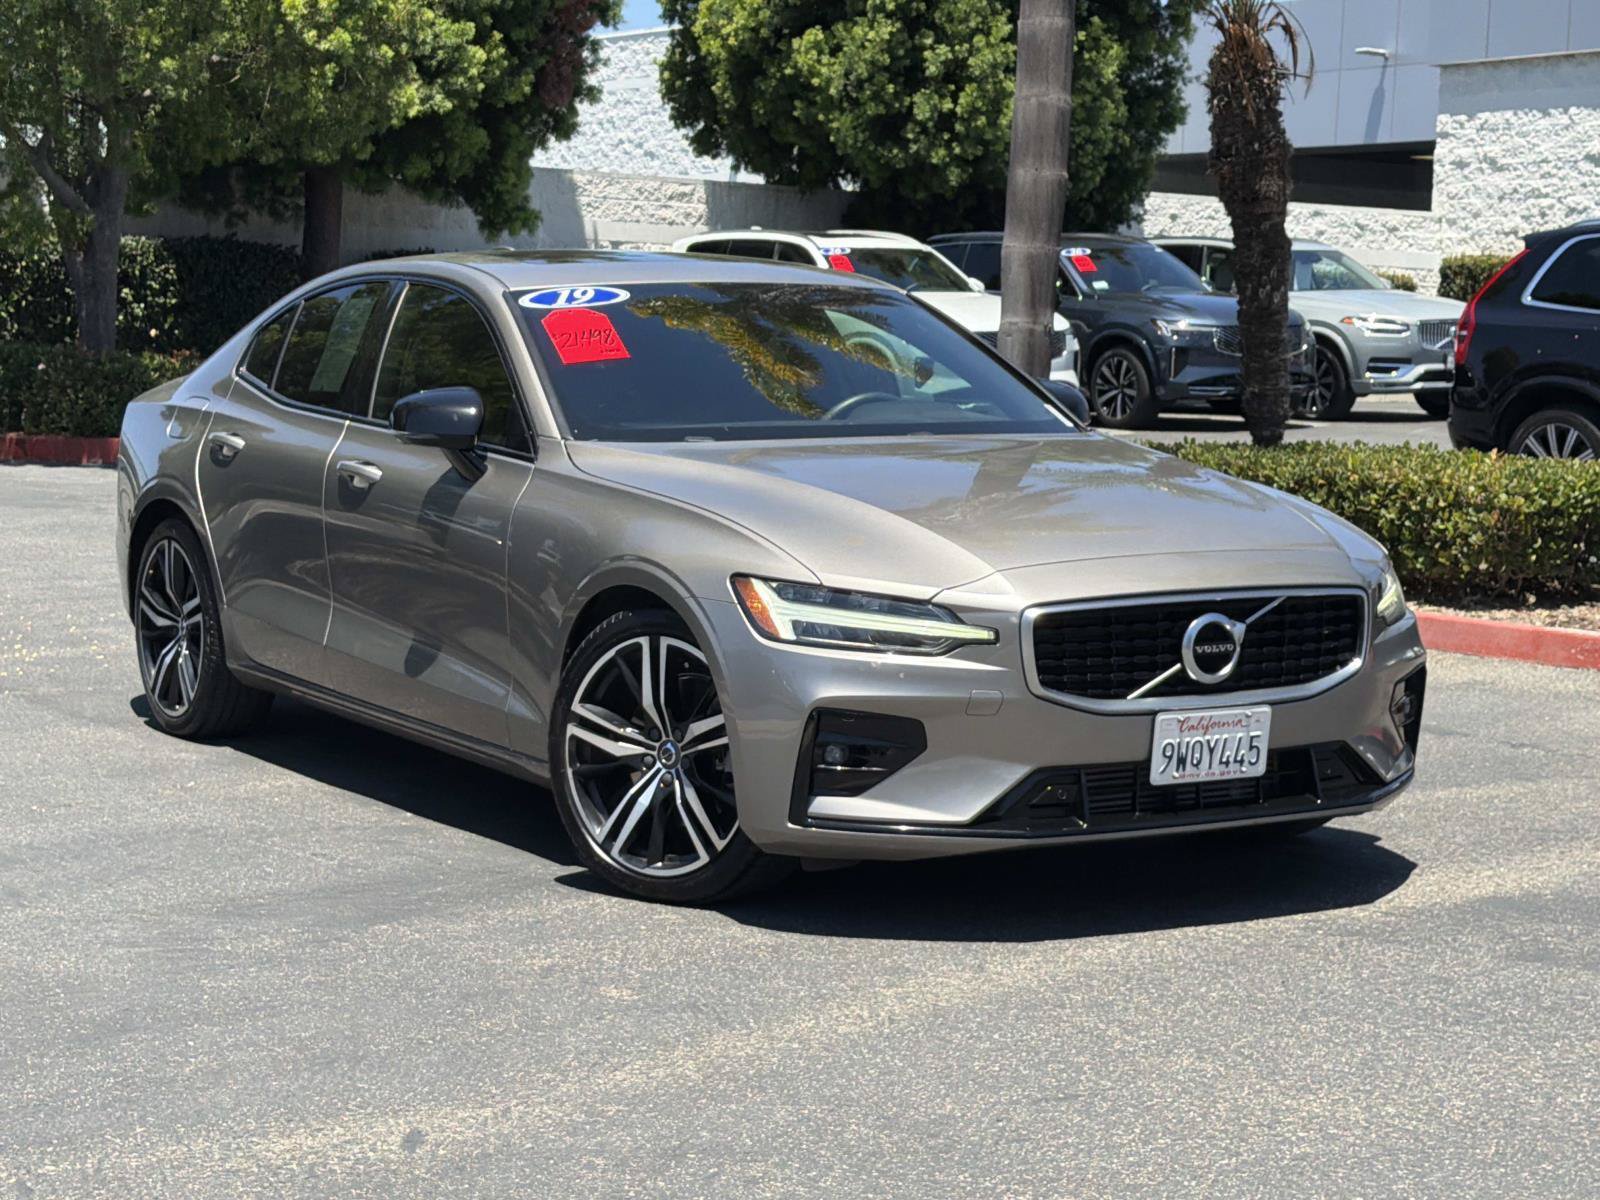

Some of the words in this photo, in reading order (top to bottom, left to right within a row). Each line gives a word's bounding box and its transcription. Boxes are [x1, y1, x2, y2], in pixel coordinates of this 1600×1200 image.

[552, 288, 595, 305] 19
[1195, 643, 1235, 654] VOLVO
[1179, 716, 1248, 735] California
[1159, 732, 1262, 774] 9WQY445
